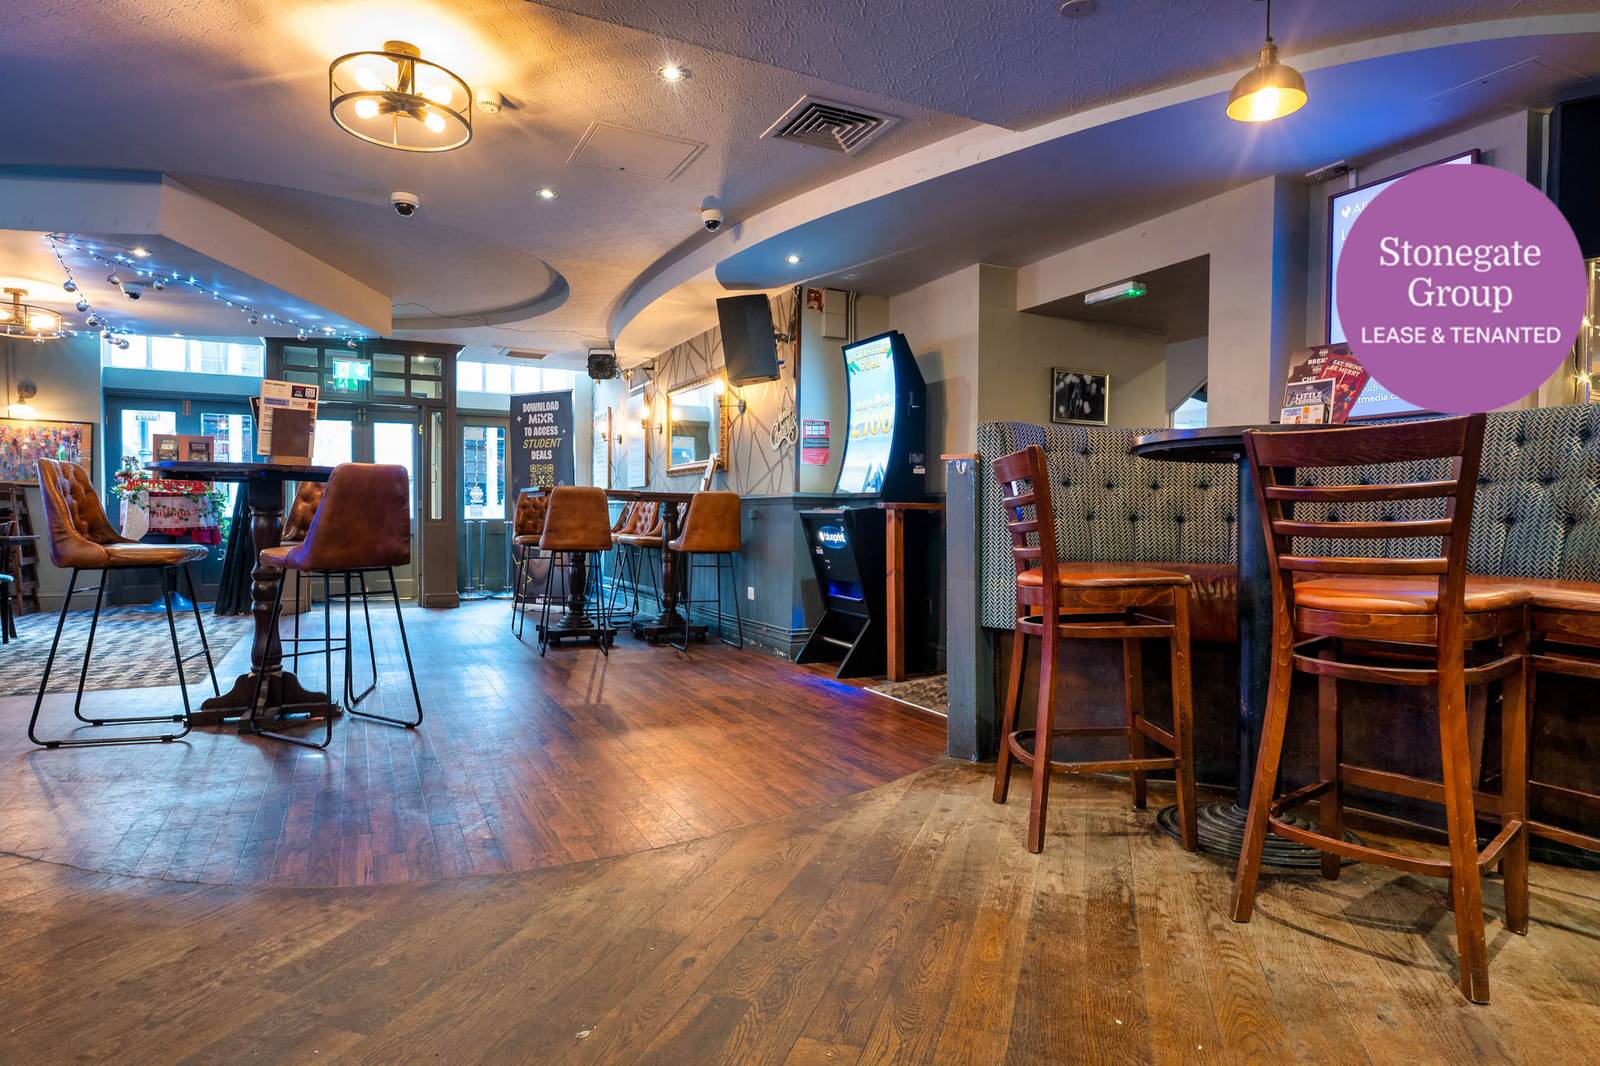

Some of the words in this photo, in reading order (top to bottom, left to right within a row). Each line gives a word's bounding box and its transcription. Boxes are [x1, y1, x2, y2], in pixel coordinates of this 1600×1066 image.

[1296, 391, 1322, 400] LITTLE
[522, 401, 560, 413] DOWNLOAD
[524, 427, 532, 437] TO
[533, 426, 559, 436] ACCESS
[522, 438, 562, 449] STUDENT
[531, 450, 553, 460] DEALS
